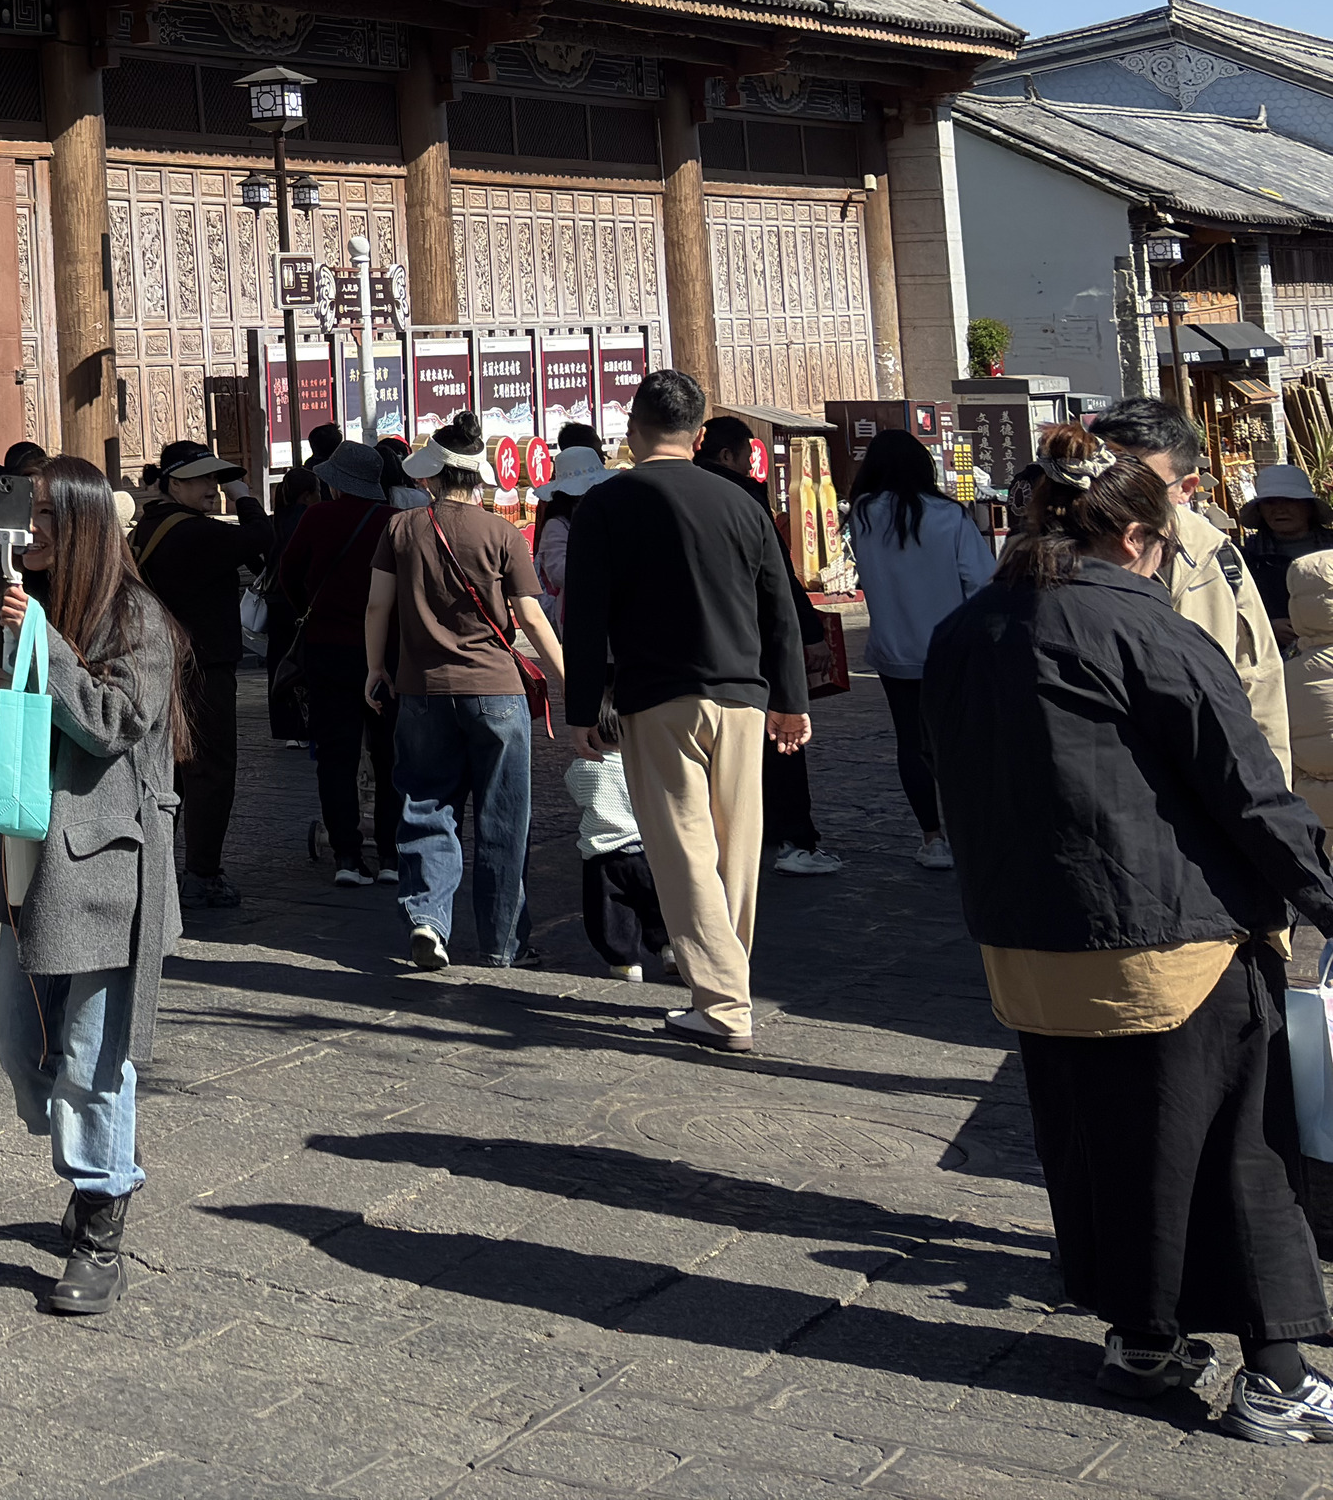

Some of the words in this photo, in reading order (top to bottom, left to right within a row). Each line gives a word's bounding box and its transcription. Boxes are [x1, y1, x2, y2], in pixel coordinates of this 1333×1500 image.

[501, 447, 516, 479] 欣
[976, 412, 994, 473] 文明是城市
